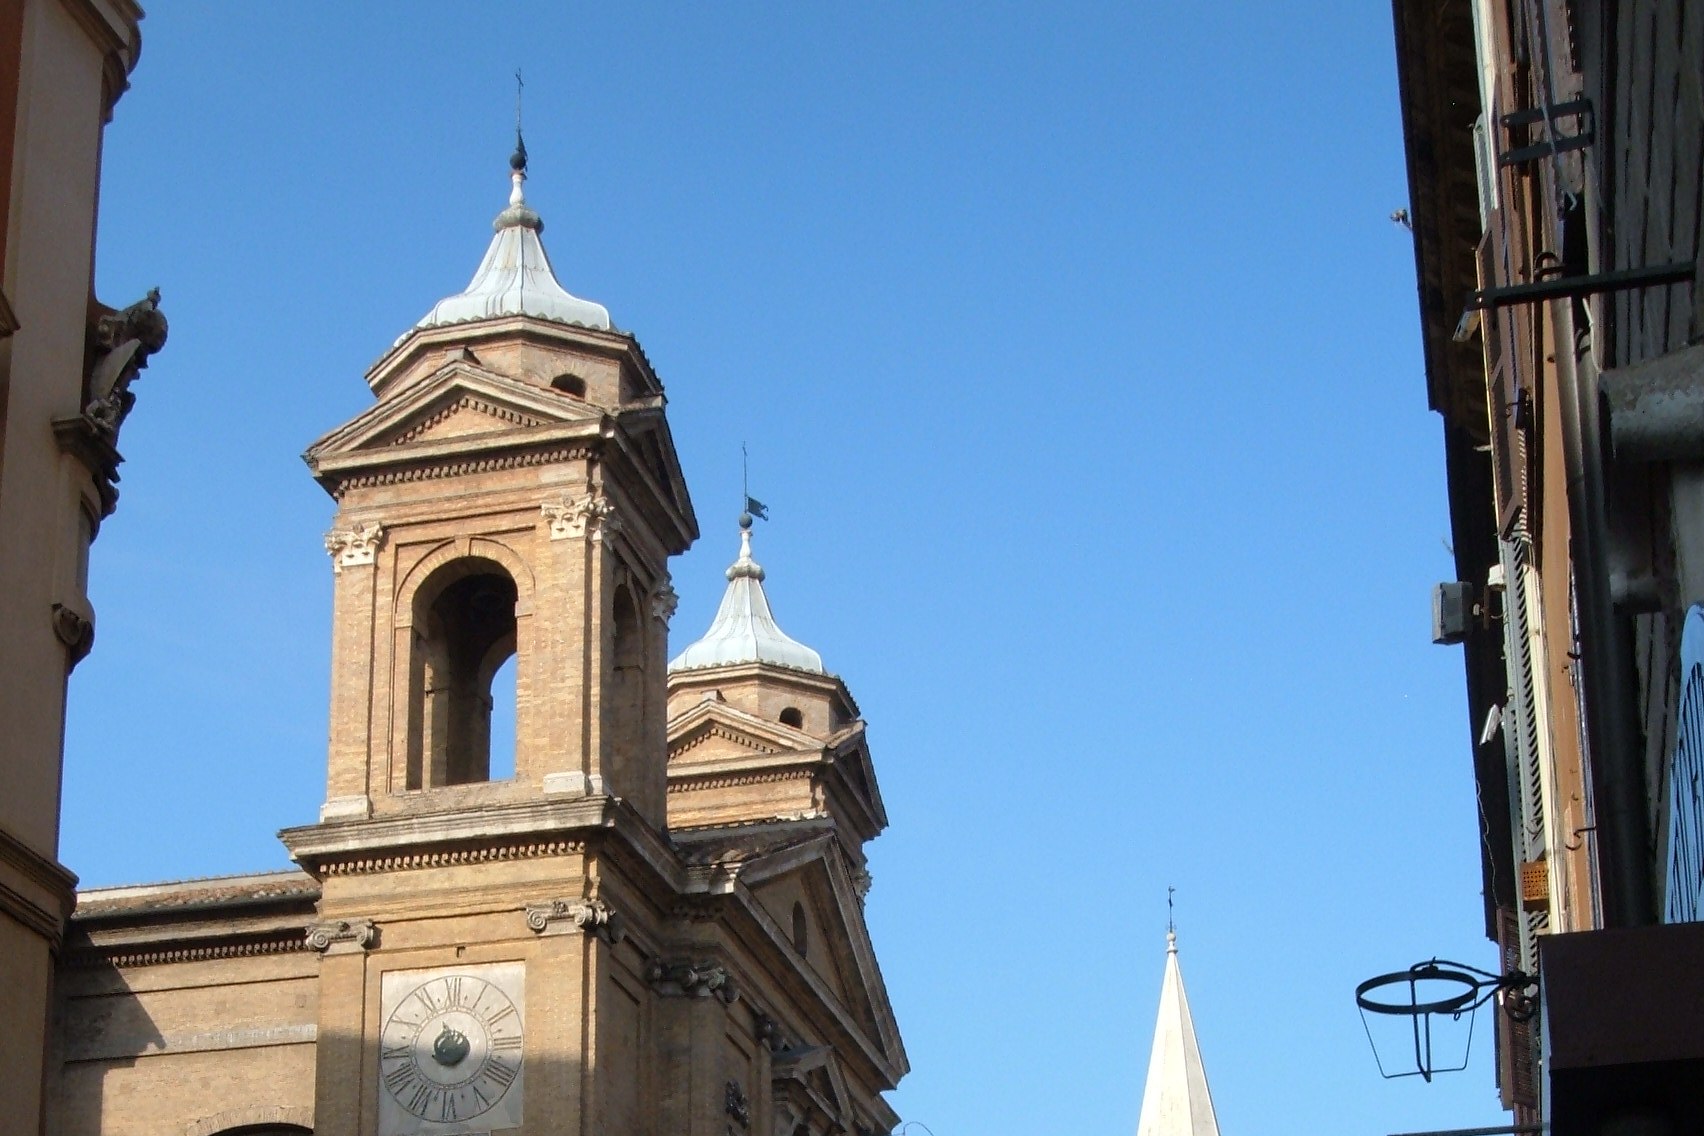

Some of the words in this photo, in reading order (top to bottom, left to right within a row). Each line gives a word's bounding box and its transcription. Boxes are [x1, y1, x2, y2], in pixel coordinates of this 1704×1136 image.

[444, 977, 462, 1007] XII
[487, 1004, 515, 1026] II
[493, 1035, 522, 1051] III
